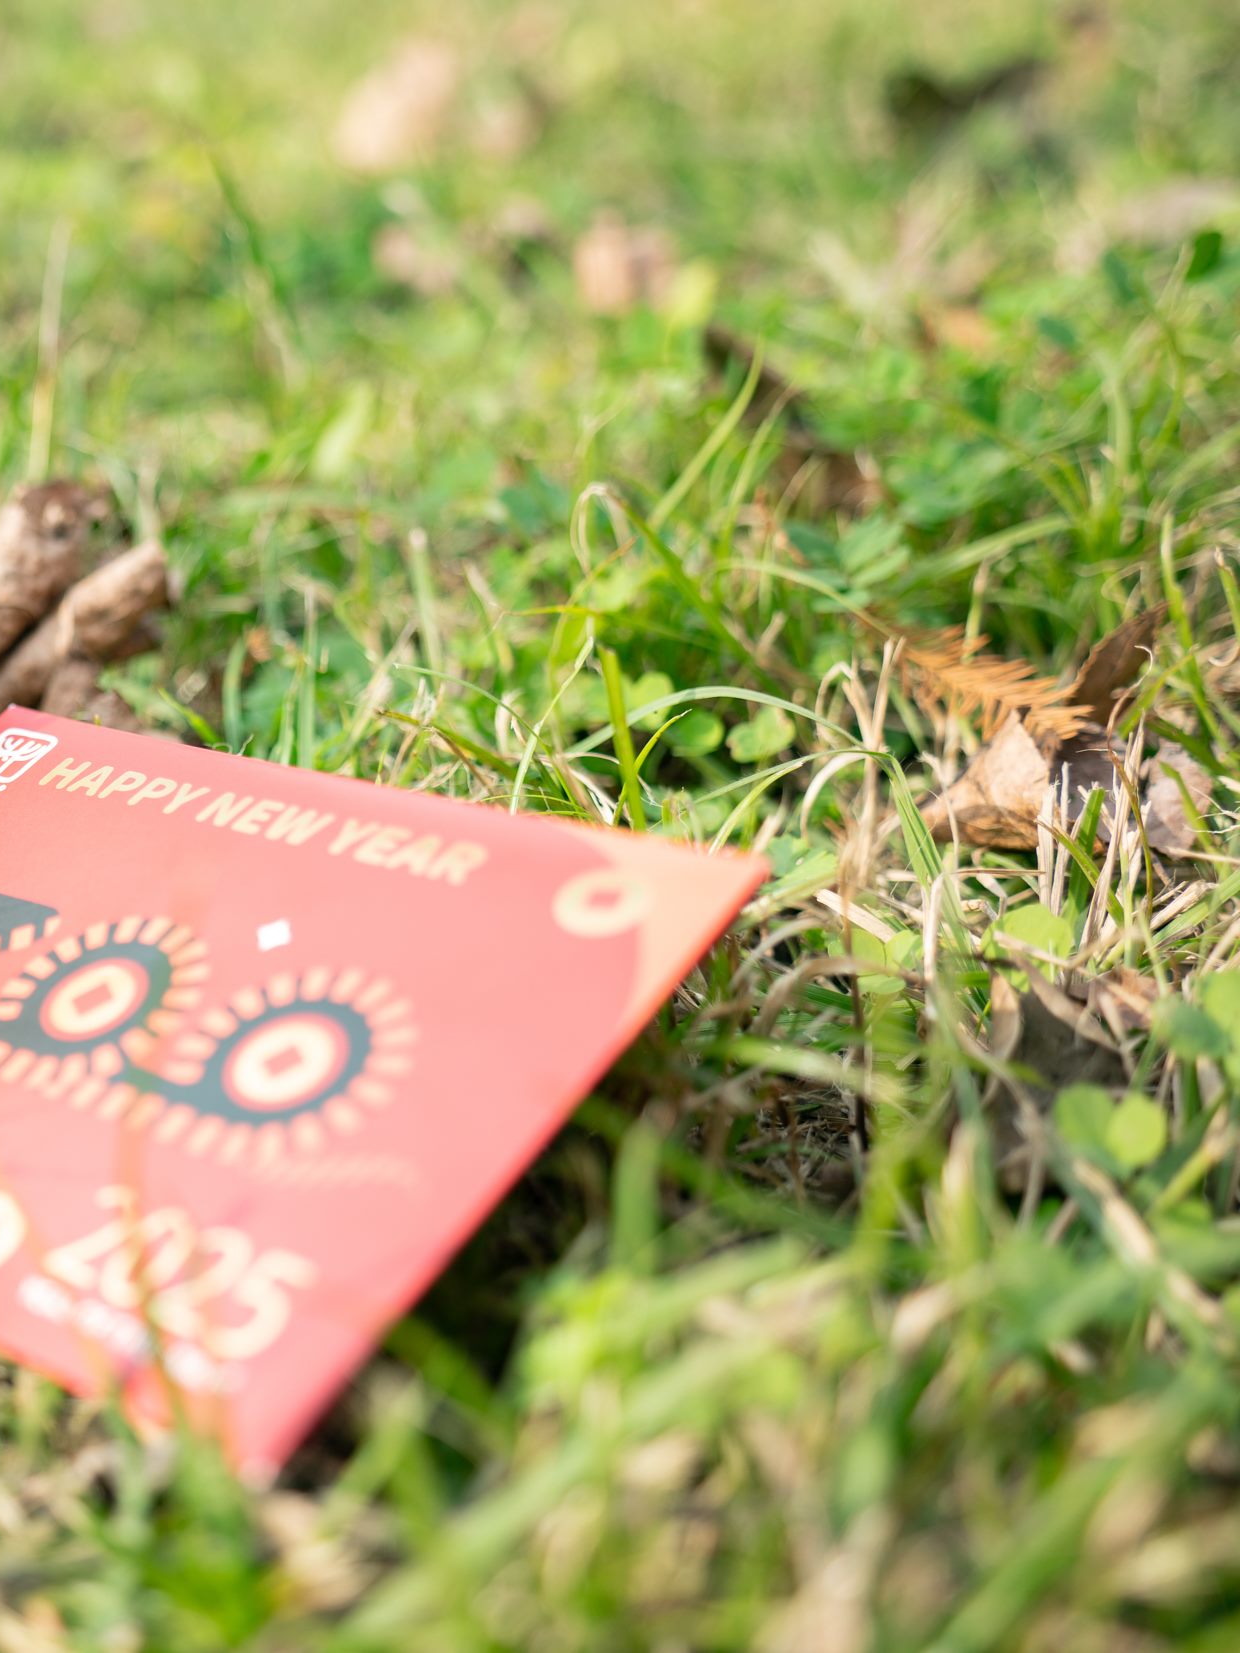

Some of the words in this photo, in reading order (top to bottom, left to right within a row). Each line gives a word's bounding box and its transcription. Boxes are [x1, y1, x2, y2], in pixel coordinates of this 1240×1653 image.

[38, 757, 211, 815] HAPPY
[194, 792, 336, 845] NEW
[327, 818, 488, 886] YEAR
[44, 1185, 318, 1359] 2025
